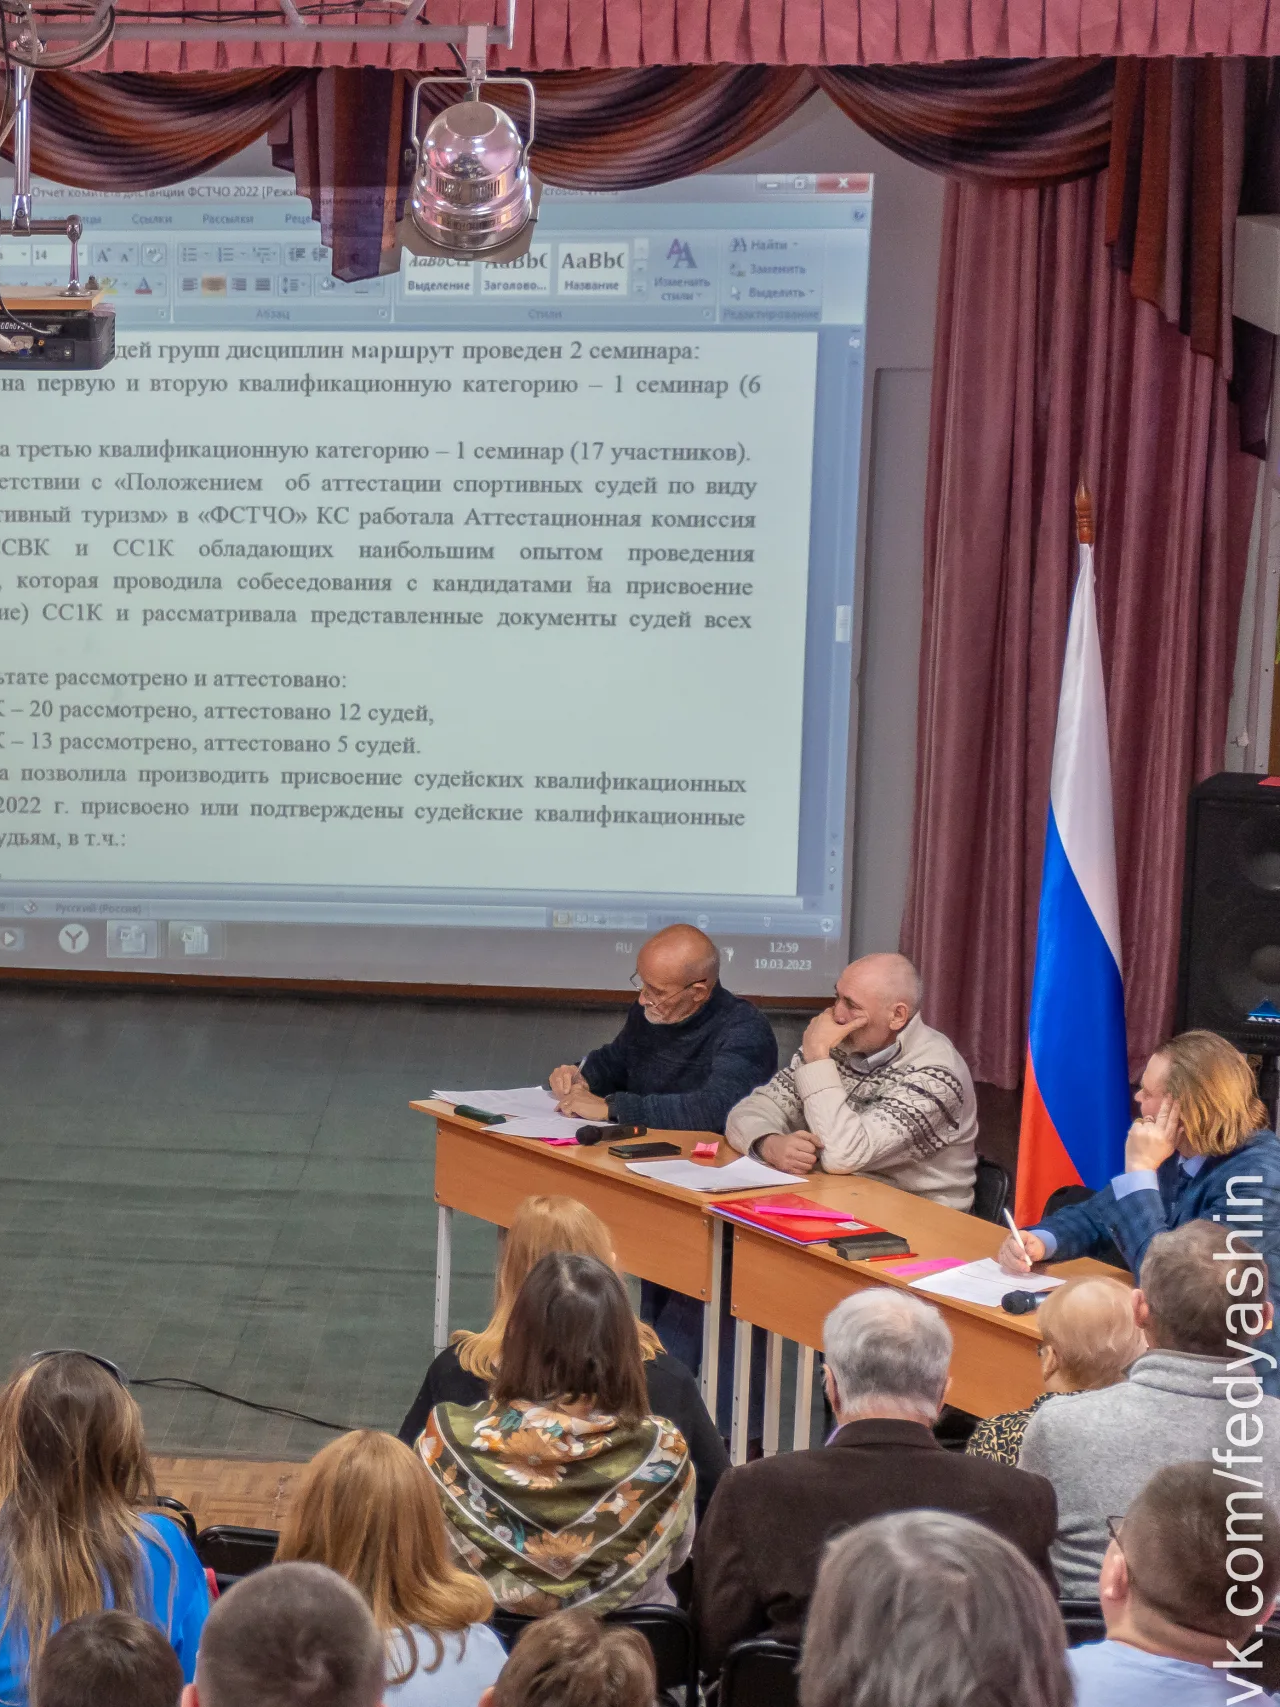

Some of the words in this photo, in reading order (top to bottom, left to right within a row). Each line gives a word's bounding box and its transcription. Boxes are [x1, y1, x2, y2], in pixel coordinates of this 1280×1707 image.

[187, 186, 231, 198] ФСТЧО
[233, 186, 259, 197] 2022
[261, 186, 297, 200] [Режи
[131, 214, 173, 226] Ссылки
[202, 214, 255, 226] Рассылки
[750, 239, 788, 250] Найти
[34, 251, 48, 260] 14
[749, 264, 806, 275] Заменить
[408, 280, 470, 292] Выделение
[564, 280, 619, 291] Название
[654, 277, 710, 288] Изменить
[660, 292, 694, 301] стили
[748, 288, 805, 299] Выделить
[527, 308, 562, 319] Стили
[115, 340, 152, 360] дей
[158, 344, 220, 363] групп
[225, 344, 343, 361] дисциплин
[352, 345, 454, 364] маршрут
[462, 345, 562, 364] проведен
[570, 340, 582, 359] 2
[589, 345, 699, 364] семинара:
[2, 377, 25, 391] на
[37, 377, 115, 396] первую
[126, 378, 139, 391] и
[150, 378, 228, 397] вторую
[239, 372, 452, 397] квалификационную
[463, 379, 578, 398] категорию
[616, 374, 622, 393] 1
[636, 379, 728, 399] семинар
[739, 374, 760, 398] (6
[16, 444, 92, 462] третью
[98, 438, 308, 463] квалификационную
[316, 445, 429, 464] категорию
[458, 440, 464, 459] 1
[474, 446, 564, 465] семинар
[570, 440, 604, 464] (17
[611, 441, 750, 466] участников).
[92, 477, 102, 490] с
[115, 472, 263, 491] «Положением
[285, 472, 310, 491] об
[321, 478, 442, 494] аттестации
[453, 479, 583, 498] спортивных
[595, 476, 657, 499] судей
[668, 480, 695, 494] по
[705, 480, 757, 500] виду
[81, 509, 168, 528] туризм»
[177, 510, 188, 523] в
[198, 505, 308, 524] «ФСТЧО»
[317, 505, 349, 524] КС
[359, 505, 454, 529] работала
[464, 507, 642, 528] Аттестационная
[651, 513, 756, 528] комиссия
[75, 543, 88, 556] и
[199, 538, 334, 560] обладающих
[359, 539, 495, 559] наибольшим
[520, 546, 603, 561] опытом
[628, 547, 755, 566] проведения
[17, 575, 98, 593] которая
[113, 575, 222, 594] проводила
[237, 571, 392, 592] собеседования
[407, 577, 417, 591] с
[432, 578, 572, 594] кандидатами
[587, 575, 612, 593] на
[626, 580, 753, 599] присвоение
[116, 607, 129, 621] и
[142, 608, 297, 627] рассматривала
[311, 609, 483, 628] представленные
[496, 611, 617, 630] документы
[629, 610, 691, 632] судей
[704, 614, 751, 629] всех
[55, 672, 187, 690] рассмотрено
[194, 673, 207, 686] и
[213, 673, 346, 688] аттестовано:
[30, 699, 53, 717] 20
[59, 704, 197, 723] рассмотрено,
[204, 705, 331, 720] аттестовано
[340, 702, 361, 721] 12
[368, 704, 433, 726] судей,
[32, 731, 52, 749] 13
[59, 736, 197, 755] рассмотрено,
[204, 737, 330, 752] аттестовано
[338, 734, 347, 752] 5
[355, 736, 420, 758] судей.
[21, 767, 127, 782] позволила
[138, 769, 269, 787] производить
[281, 771, 402, 789] присвоение
[414, 769, 524, 791] судейских
[535, 770, 747, 795] квалификационных
[54, 800, 68, 814] г.
[81, 800, 189, 819] присвоено
[201, 802, 238, 816] или
[250, 803, 404, 822] подтверждены
[414, 803, 523, 824] судейские
[535, 804, 745, 828] квалификационные
[68, 832, 79, 846] в
[769, 942, 799, 953] 12:59
[754, 959, 812, 971] 19.03.2023
